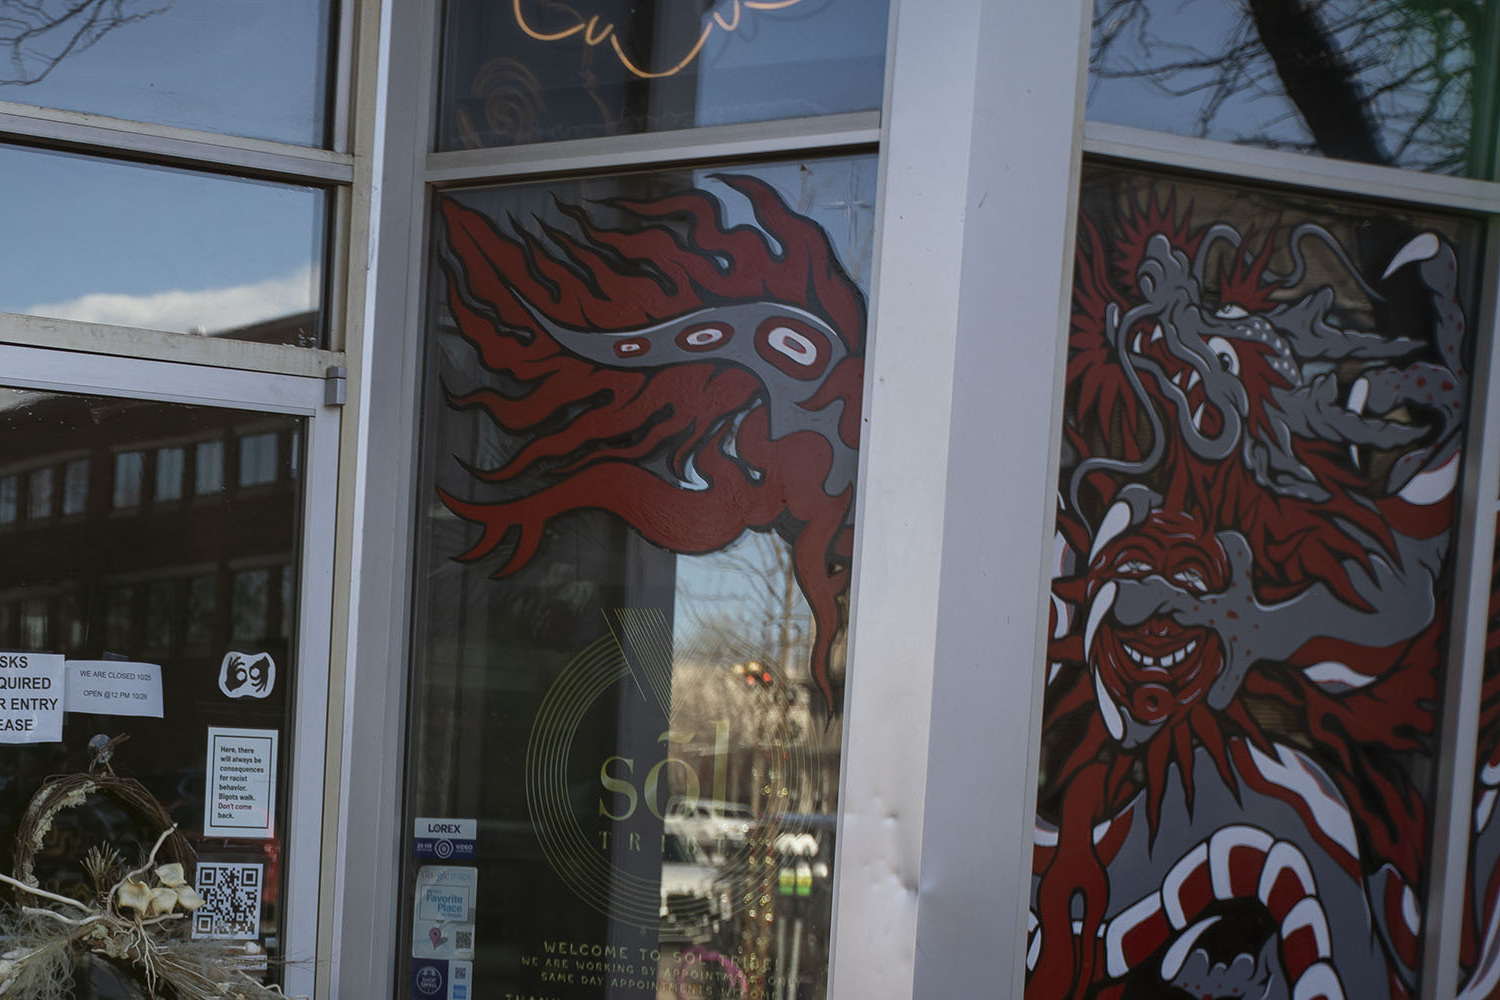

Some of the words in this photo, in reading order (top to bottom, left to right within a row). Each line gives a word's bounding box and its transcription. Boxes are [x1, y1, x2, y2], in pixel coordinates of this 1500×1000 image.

[93, 671, 107, 679] ARE
[107, 672, 136, 681] CLOSED
[83, 690, 103, 698] OPEN
[10, 697, 59, 711] ENTRY
[220, 746, 237, 754] Here,
[238, 746, 255, 754] there
[220, 755, 231, 763] will
[232, 755, 253, 765] always
[219, 765, 264, 774] consequences
[219, 774, 228, 782] for
[218, 793, 238, 801] Bigots
[218, 802, 234, 810] Don't
[235, 803, 252, 811] come
[217, 811, 235, 819] back.
[428, 823, 461, 834] LOREX
[427, 893, 464, 905] Favorite
[437, 903, 463, 914] Place
[543, 939, 628, 960] WELCOME
[639, 947, 661, 962] TO
[673, 950, 707, 966] SOL
[521, 955, 540, 967] WE
[544, 957, 569, 969] ARE
[575, 960, 634, 974] WORKING
[641, 966, 657, 977] BY
[541, 971, 574, 984] SAME
[581, 975, 604, 987] DAY
